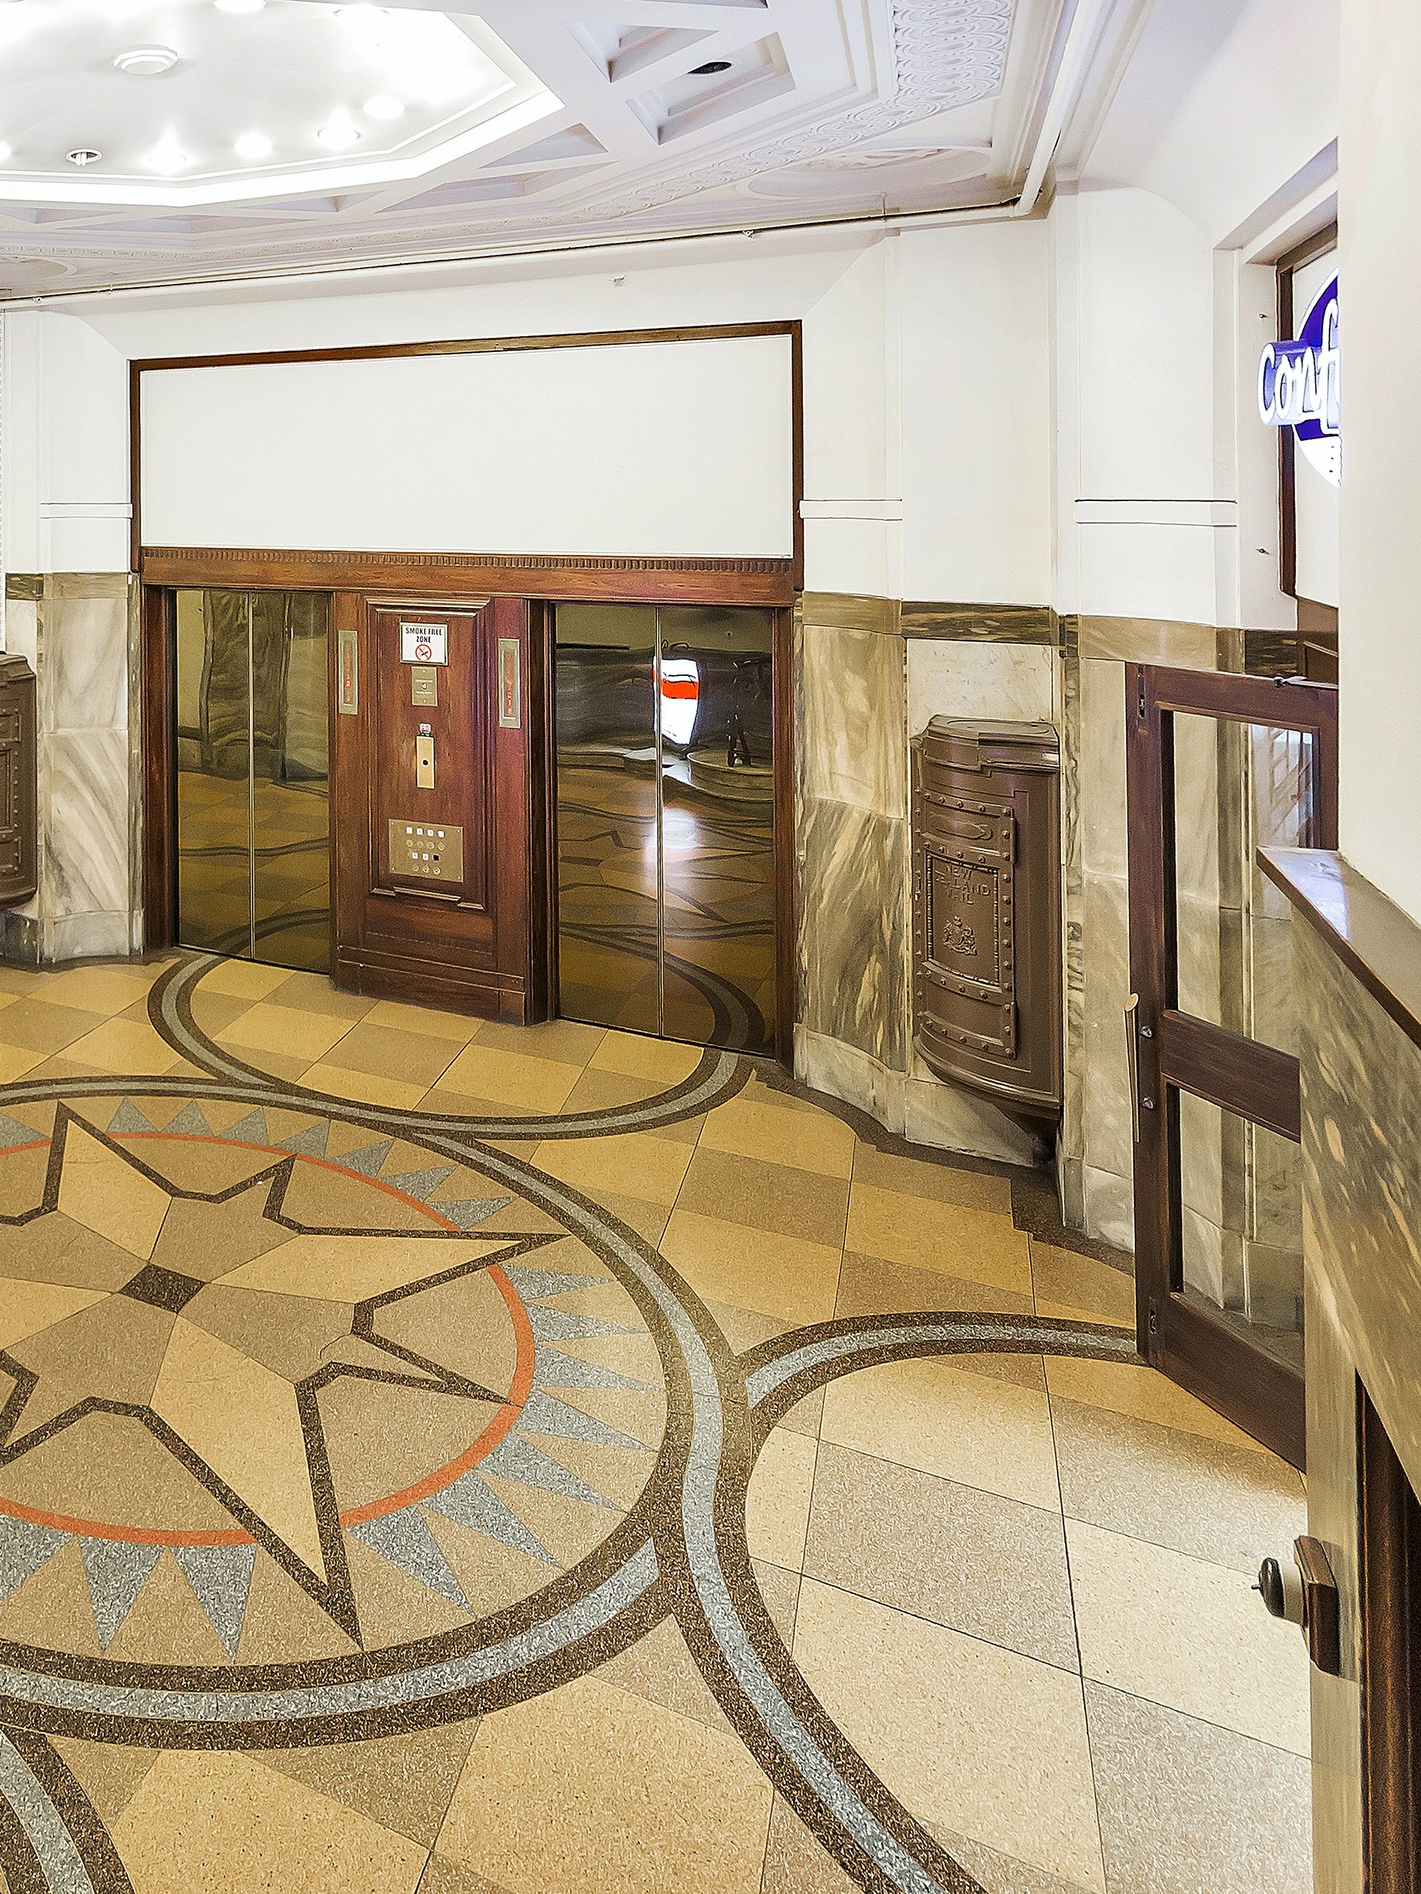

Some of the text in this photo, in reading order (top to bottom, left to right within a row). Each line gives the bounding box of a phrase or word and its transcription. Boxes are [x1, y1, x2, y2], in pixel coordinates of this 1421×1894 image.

[405, 627, 442, 636] SMOKE FREE
[416, 635, 431, 643] ZONE
[945, 864, 972, 880] NEW
